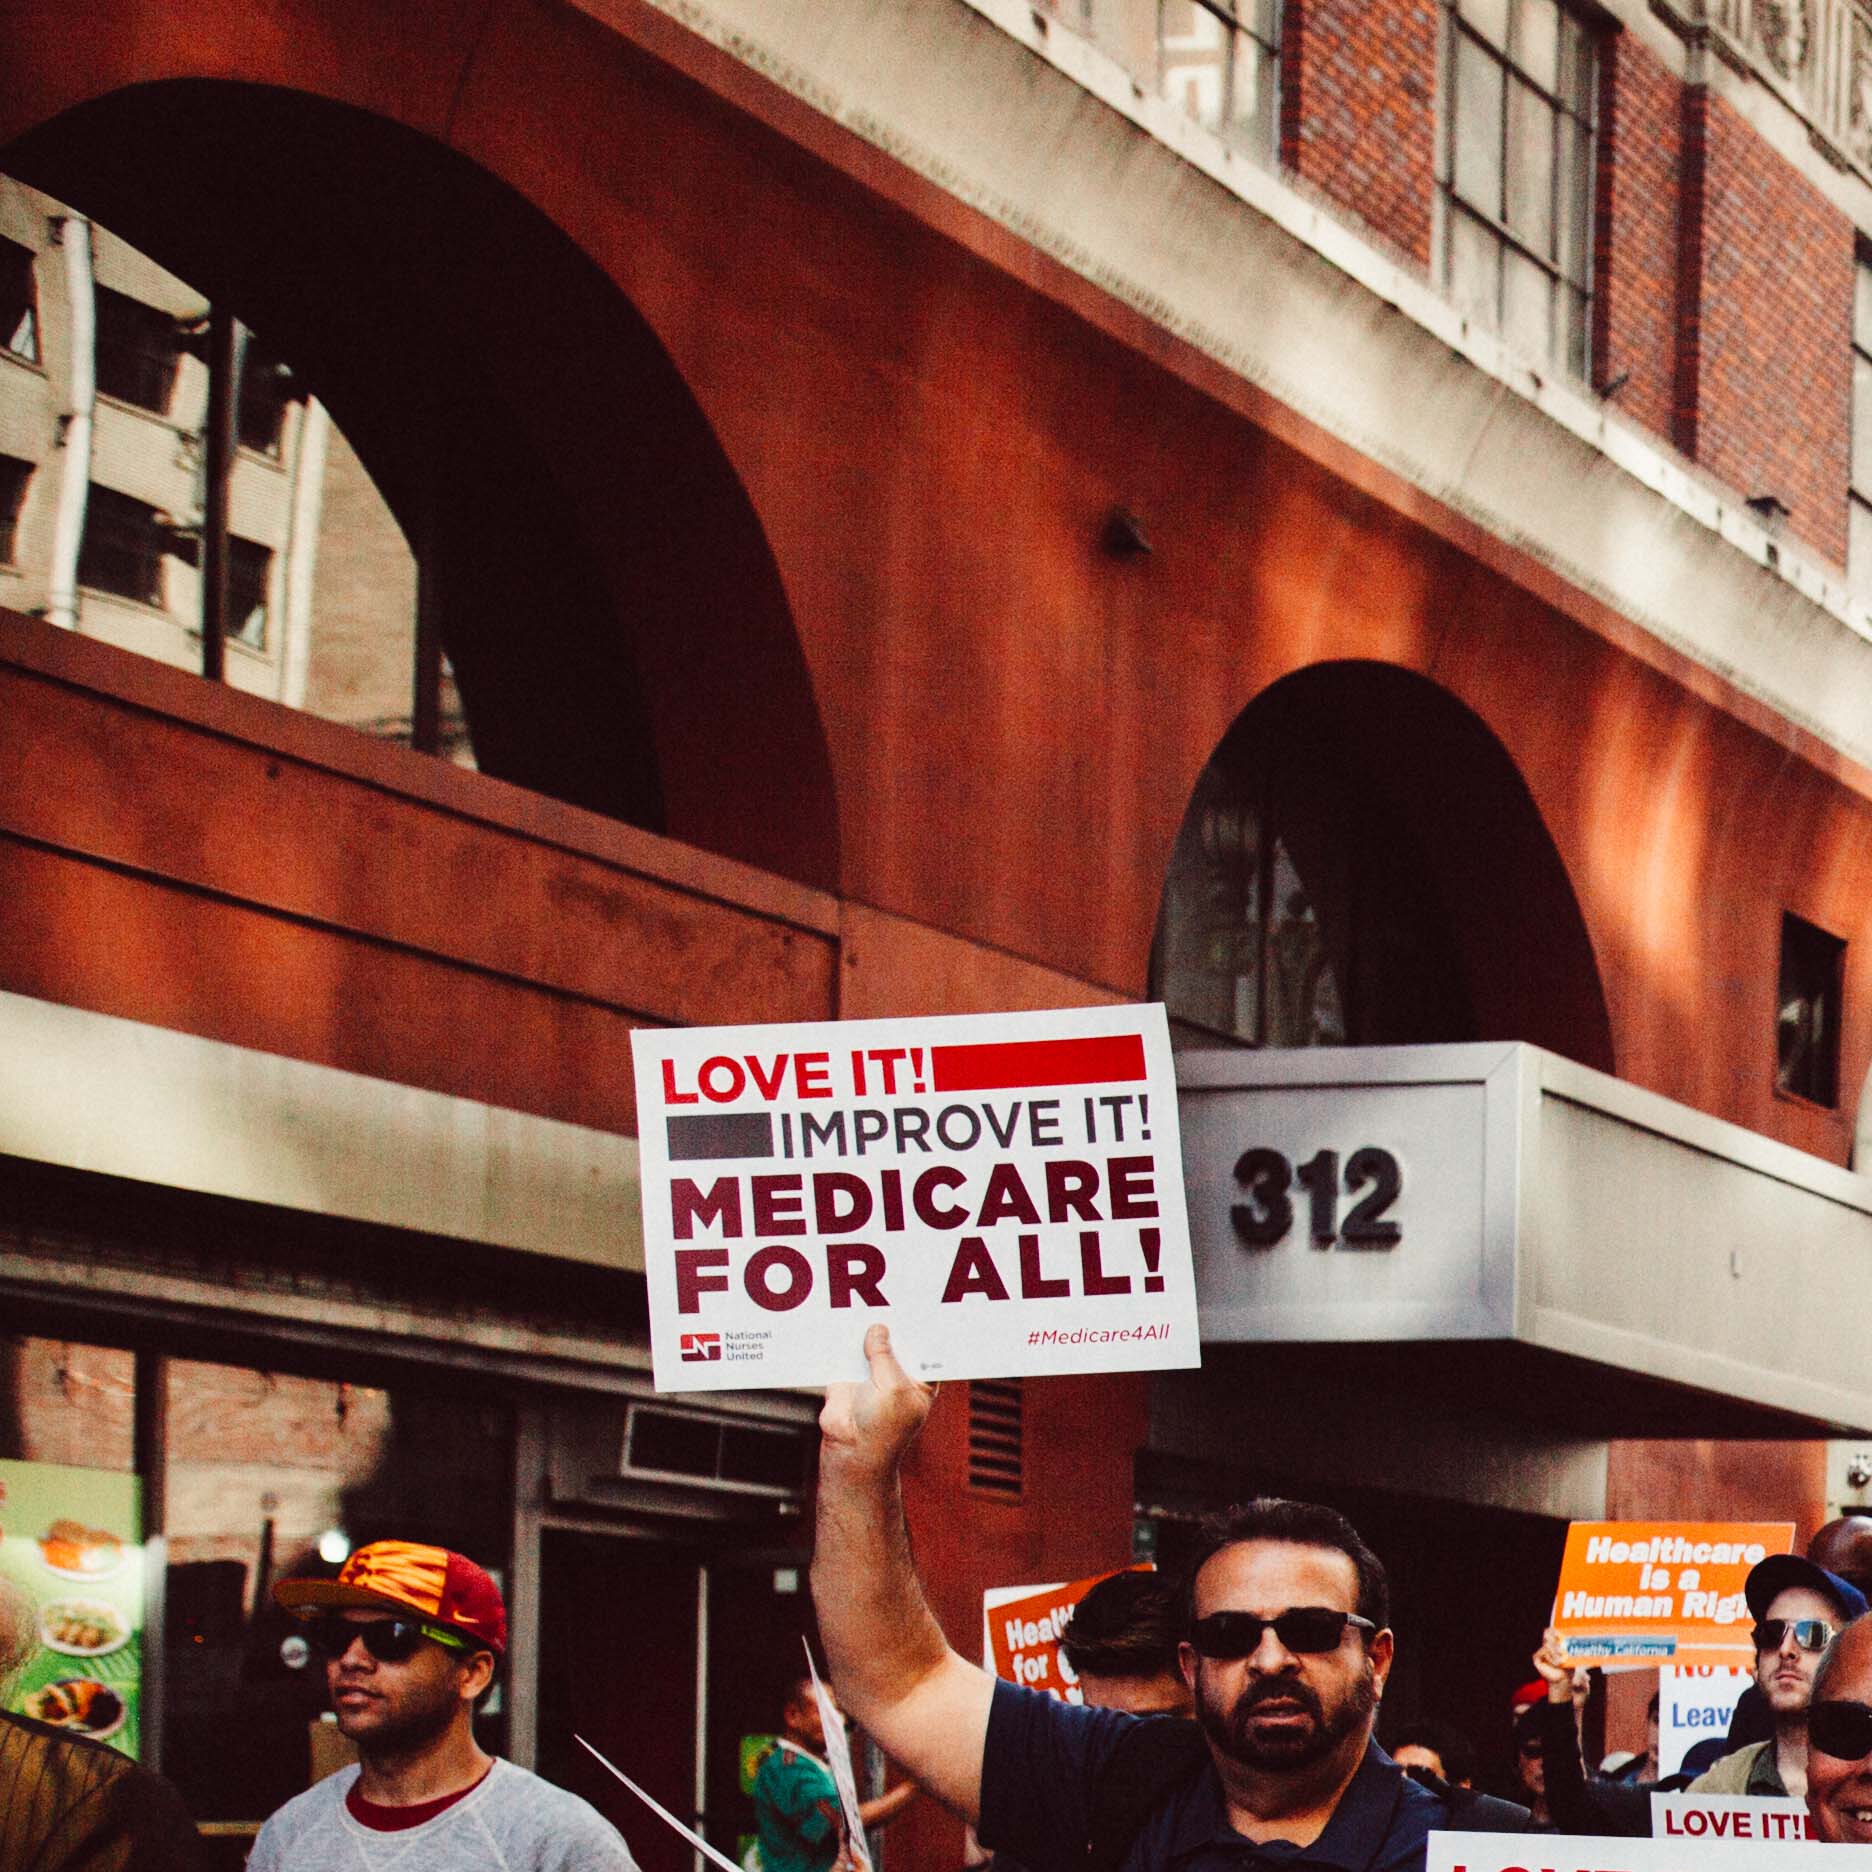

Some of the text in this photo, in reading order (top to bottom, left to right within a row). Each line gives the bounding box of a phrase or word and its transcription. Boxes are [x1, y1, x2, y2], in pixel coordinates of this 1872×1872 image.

[661, 1048, 926, 1104] LOVE IT!
[780, 1094, 1151, 1160] IMPROVE IT!
[669, 1156, 1159, 1239] MEDICARE
[1230, 1148, 1402, 1252] 312
[674, 1228, 1164, 1314] FOR ALL!
[725, 1330, 772, 1341] National
[726, 1341, 764, 1351] Nurses
[1028, 1324, 1170, 1347] #Medicare4All
[726, 1351, 764, 1361] United
[1587, 1537, 1766, 1564] Healthcare
[1639, 1564, 1700, 1590] is a
[1562, 1591, 1752, 1624] Human Righ
[1013, 1653, 1048, 1685] for
[1672, 1703, 1731, 1728] Leav
[1665, 1809, 1801, 1840] LOVE IT!
